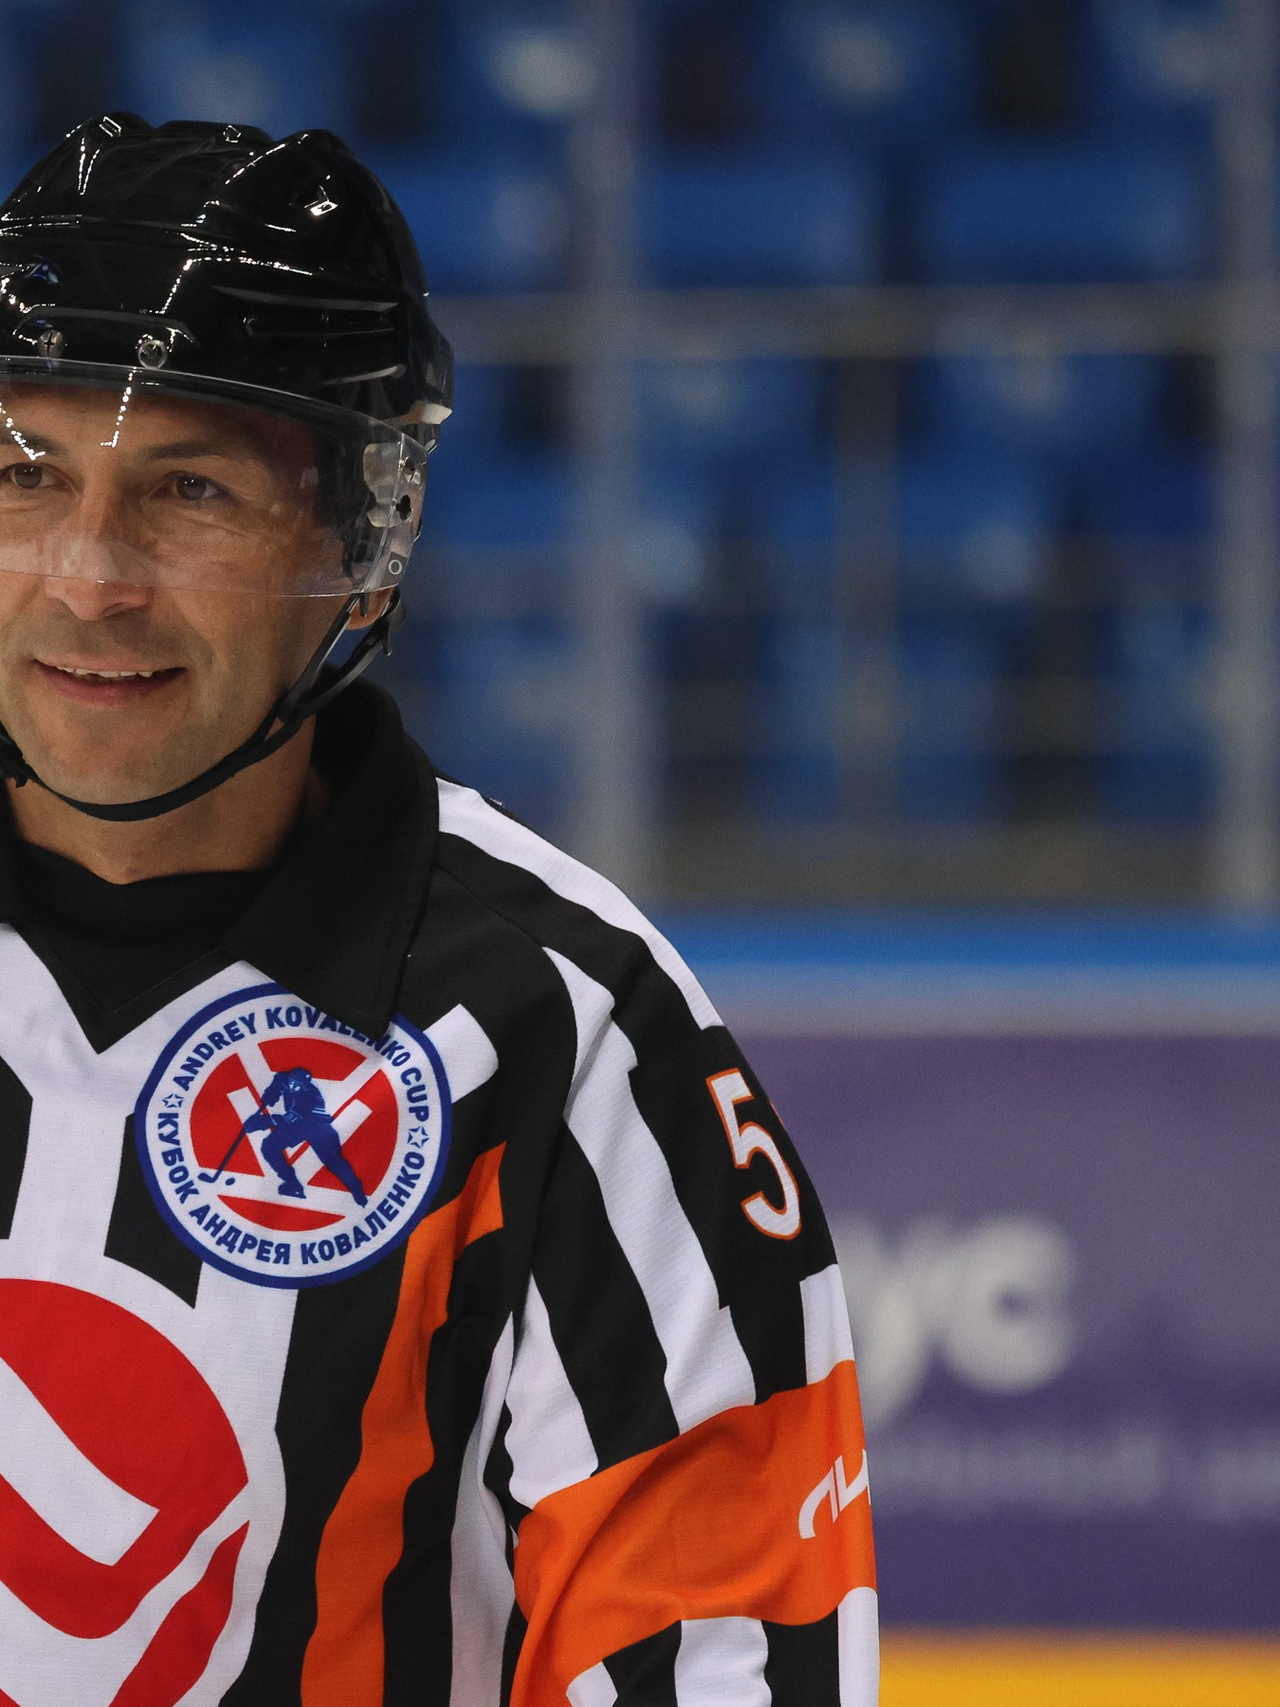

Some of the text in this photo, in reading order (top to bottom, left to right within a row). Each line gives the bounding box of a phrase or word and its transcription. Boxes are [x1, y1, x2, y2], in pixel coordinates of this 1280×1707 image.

[173, 1013, 258, 1092] ANDREY
[400, 1067, 430, 1123] CUP
[157, 1112, 425, 1265] КУБОК АНДРЕЯ КОВАЛЕНКО
[707, 1068, 802, 1240] 5
